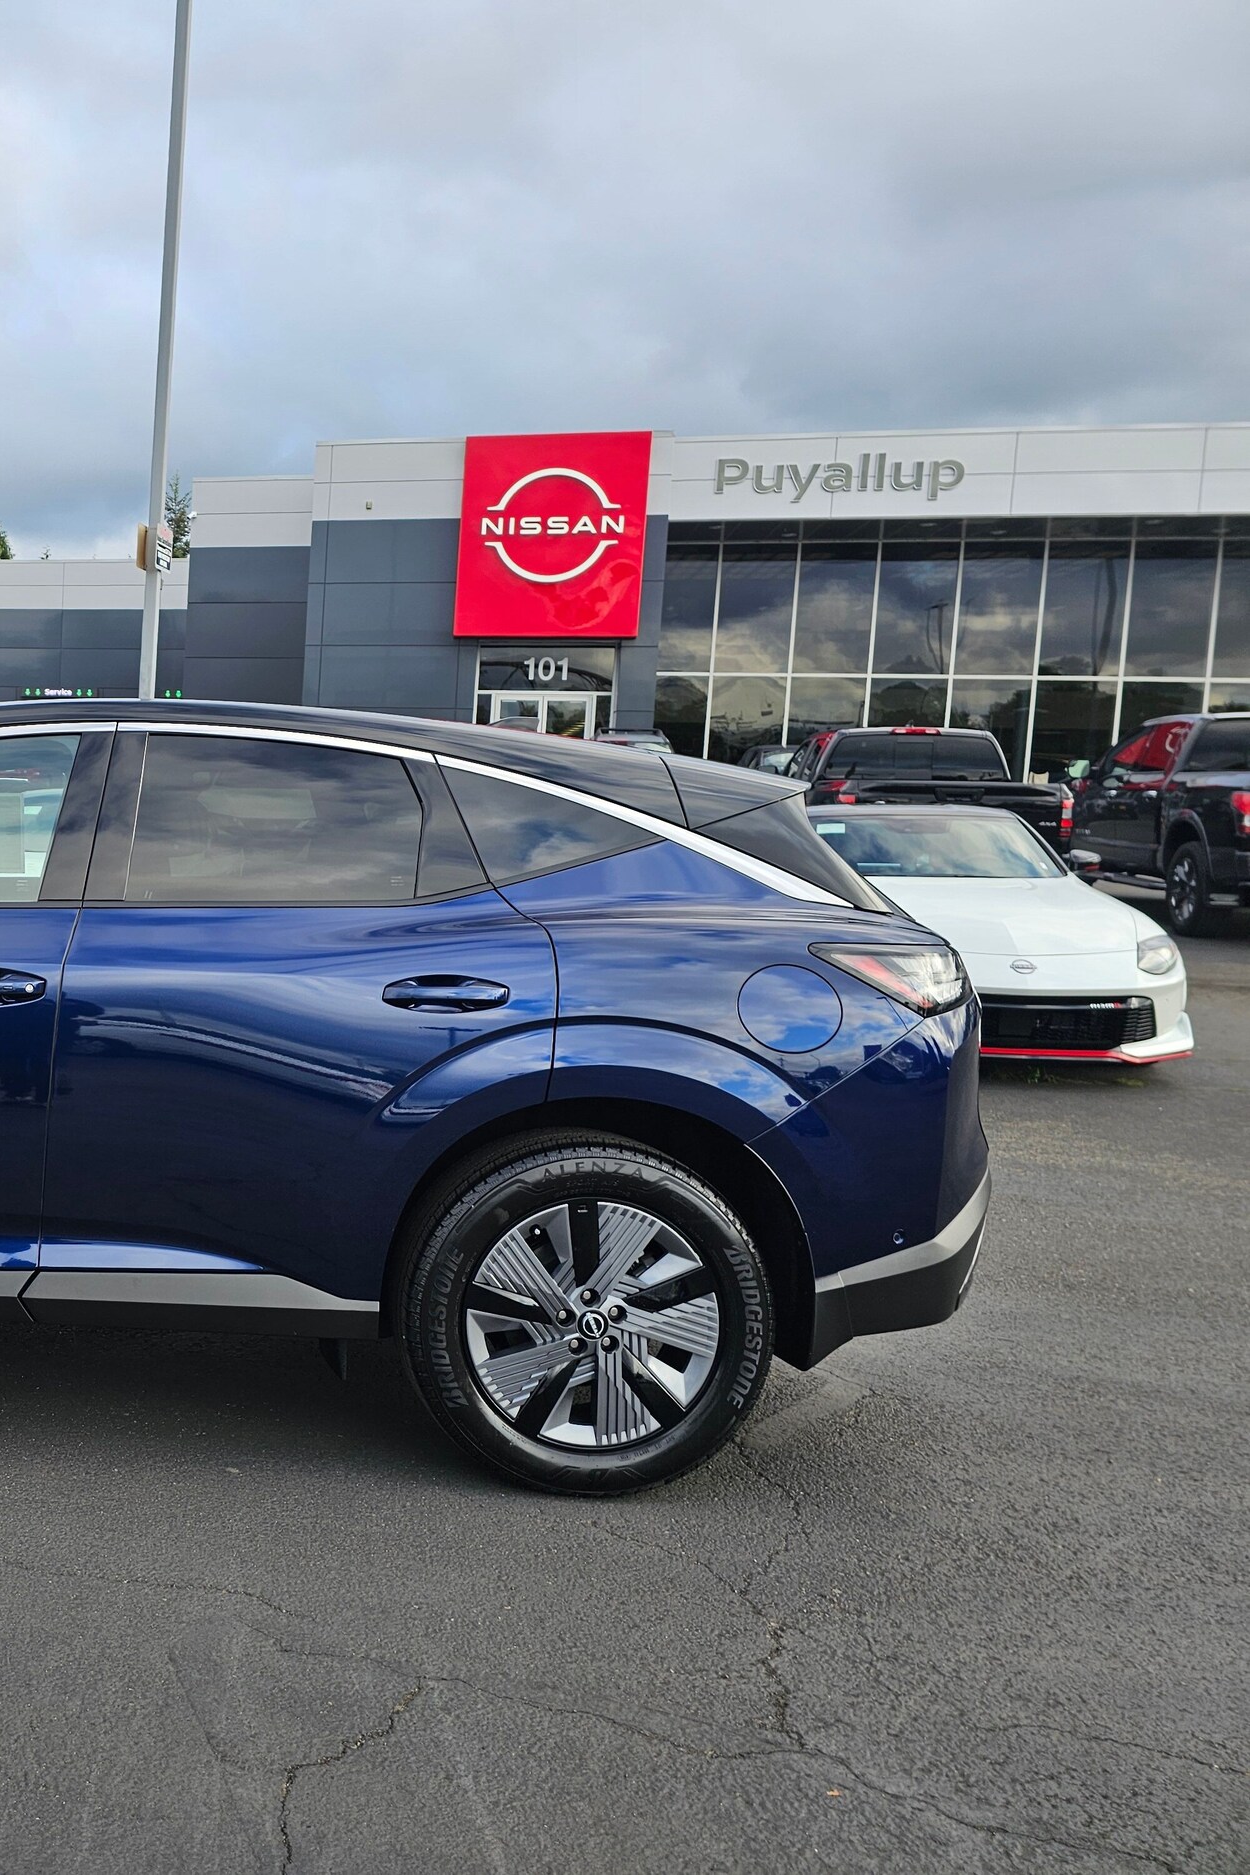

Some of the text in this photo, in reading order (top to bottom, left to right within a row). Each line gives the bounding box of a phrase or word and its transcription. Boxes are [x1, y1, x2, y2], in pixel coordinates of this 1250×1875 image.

[714, 452, 966, 503] Puyallup
[480, 515, 625, 536] NISSAN
[524, 656, 569, 681] 101
[44, 688, 73, 697] Service
[542, 1161, 643, 1182] ALENZA
[428, 1249, 469, 1408] BRIDGESTONE
[723, 1246, 763, 1409] BRIDGESTONE
